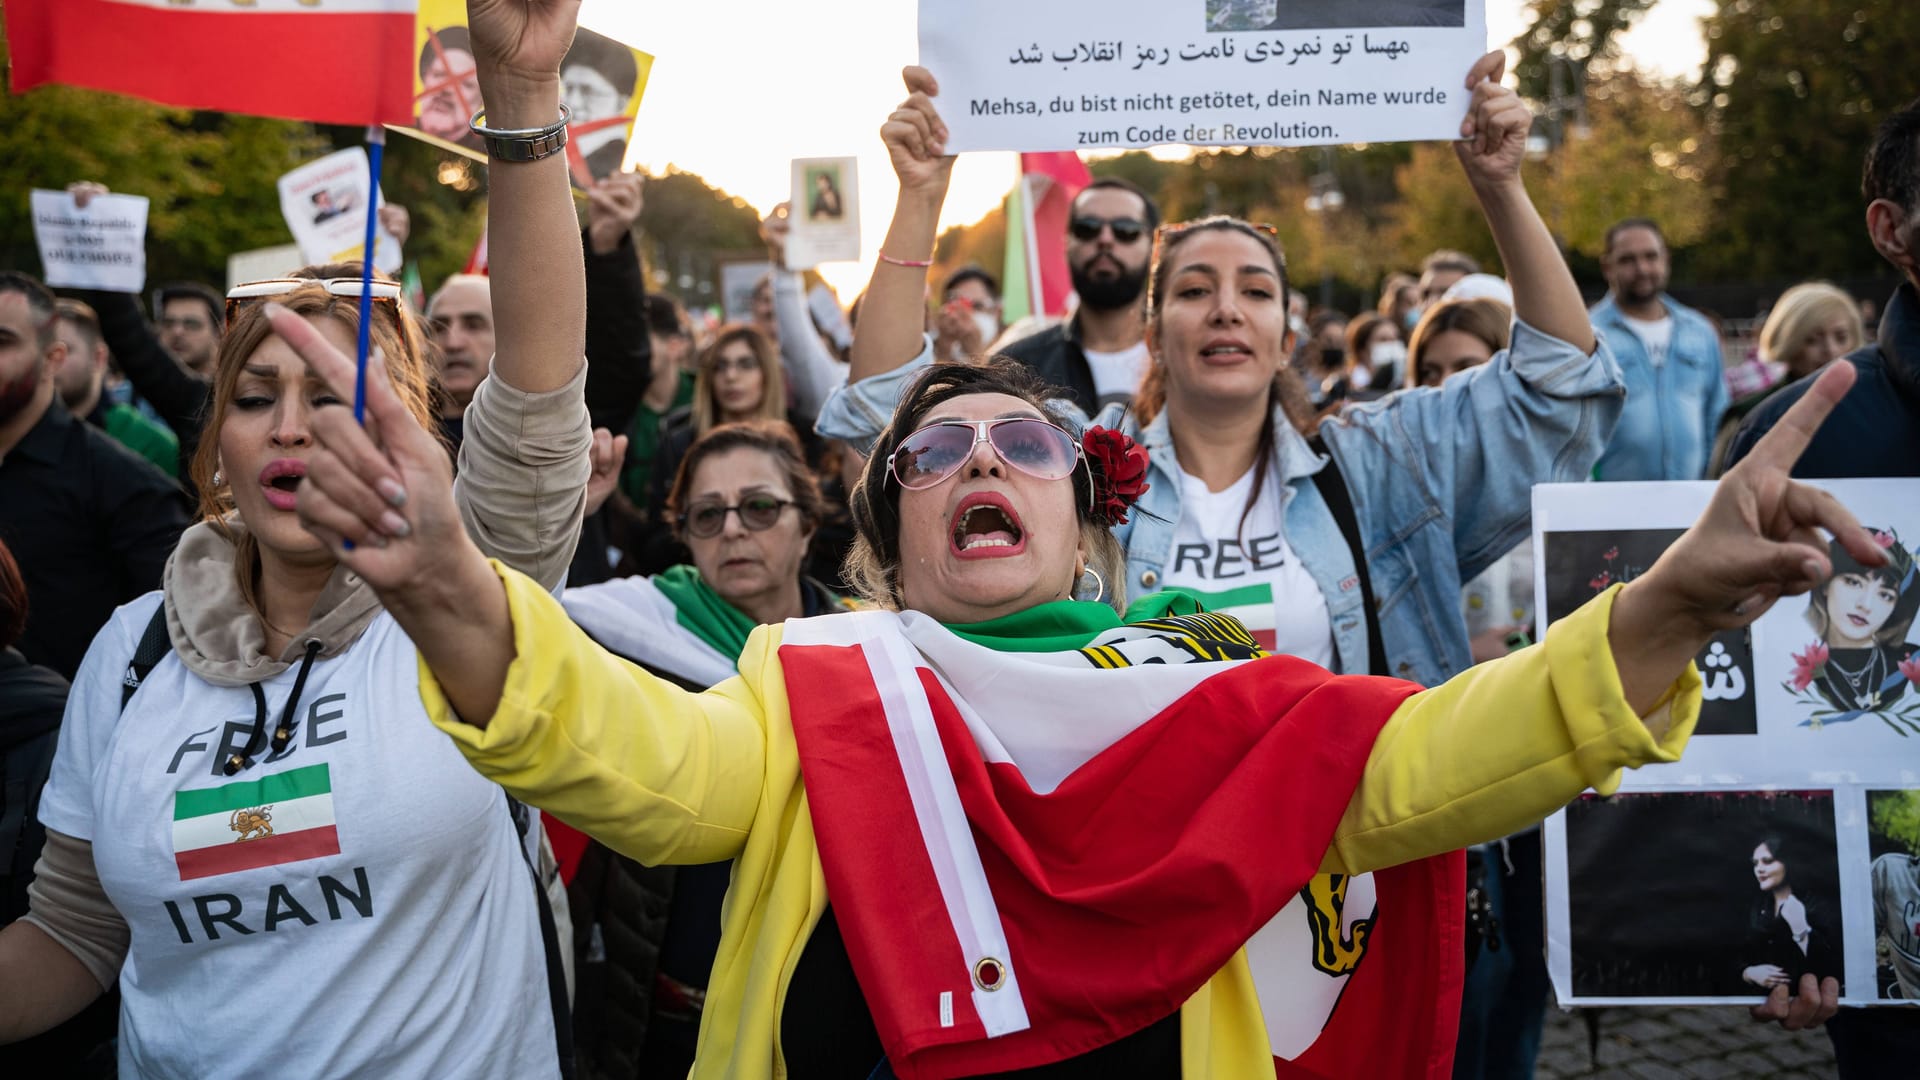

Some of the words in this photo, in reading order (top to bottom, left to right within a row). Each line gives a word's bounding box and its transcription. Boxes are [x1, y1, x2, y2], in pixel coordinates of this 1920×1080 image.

[1008, 42, 1044, 65] شد
[1051, 40, 1123, 72] انقلاب
[1131, 44, 1170, 71] رمز
[1178, 37, 1236, 63] نامت
[1243, 36, 1323, 67] نمردی
[1330, 35, 1353, 66] تو
[1363, 34, 1411, 61] مهسا
[970, 96, 1044, 118] Mehsa,
[1048, 95, 1075, 114] du
[1080, 94, 1118, 113] bist
[1123, 92, 1174, 112] nicht
[1179, 90, 1261, 114] getötet,
[1266, 88, 1311, 108] dein
[1317, 88, 1378, 107] Name
[1383, 86, 1447, 105] wurde
[1077, 130, 1120, 145] zum
[1125, 124, 1177, 143] Code
[1182, 123, 1216, 142] der
[1222, 121, 1340, 141] Revolution.
[1174, 532, 1285, 580] REE
[164, 866, 374, 944] IRAN
